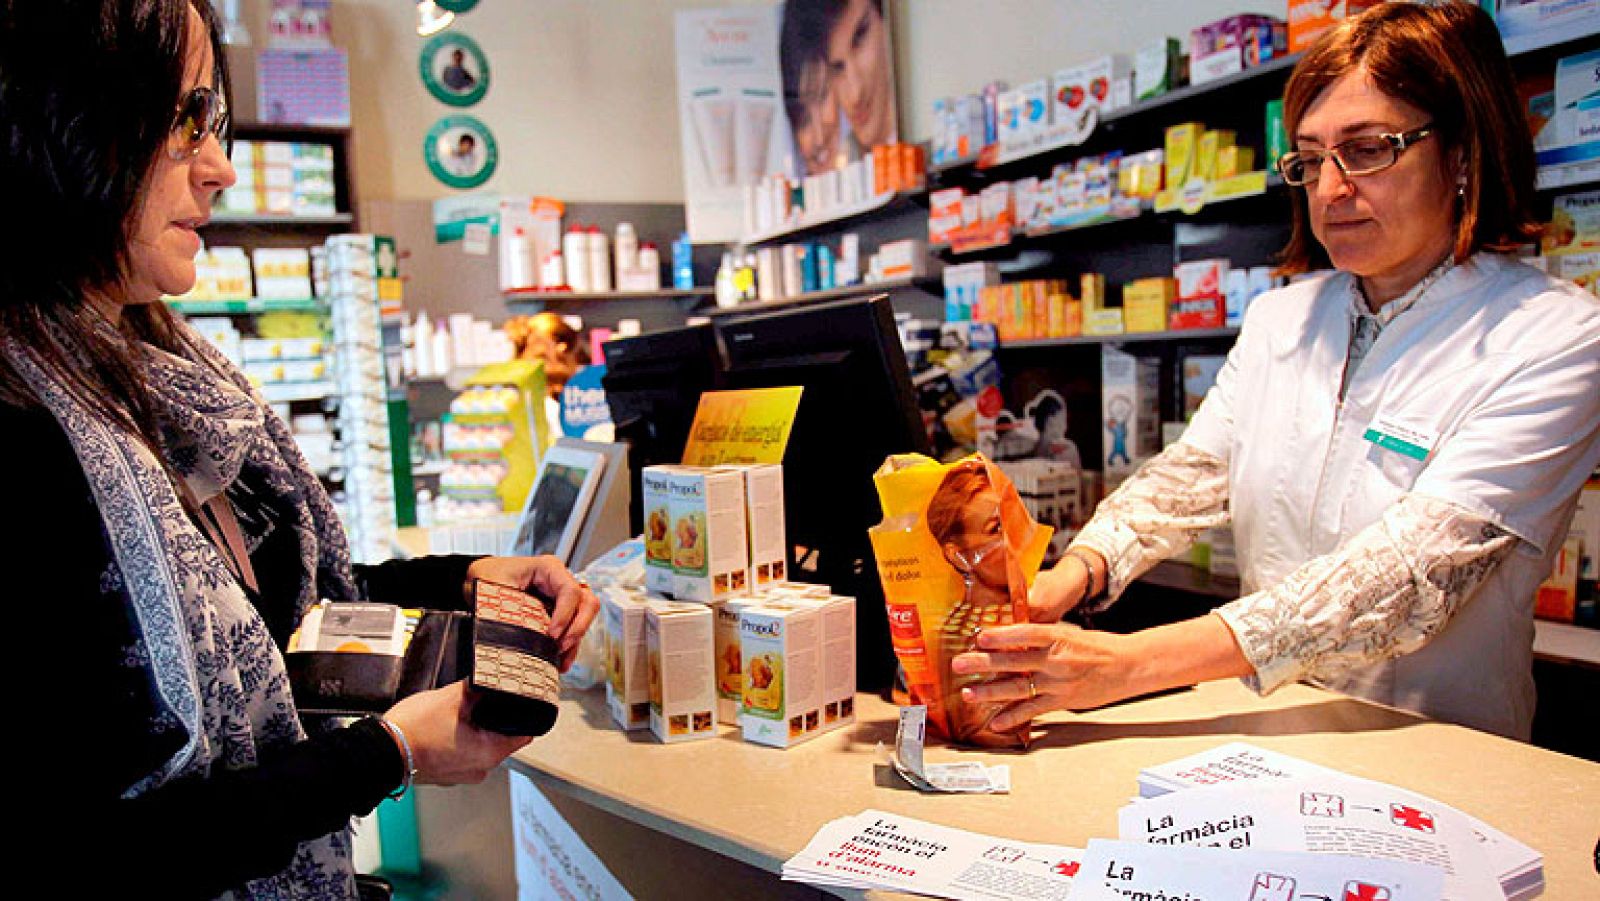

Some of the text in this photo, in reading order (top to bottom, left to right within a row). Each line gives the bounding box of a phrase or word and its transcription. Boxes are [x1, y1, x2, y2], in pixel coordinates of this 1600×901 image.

[875, 819, 898, 831] La
[1146, 814, 1175, 834] La
[1147, 815, 1255, 847] farmàcia
[1228, 832, 1251, 850] el
[1105, 860, 1135, 881] La
